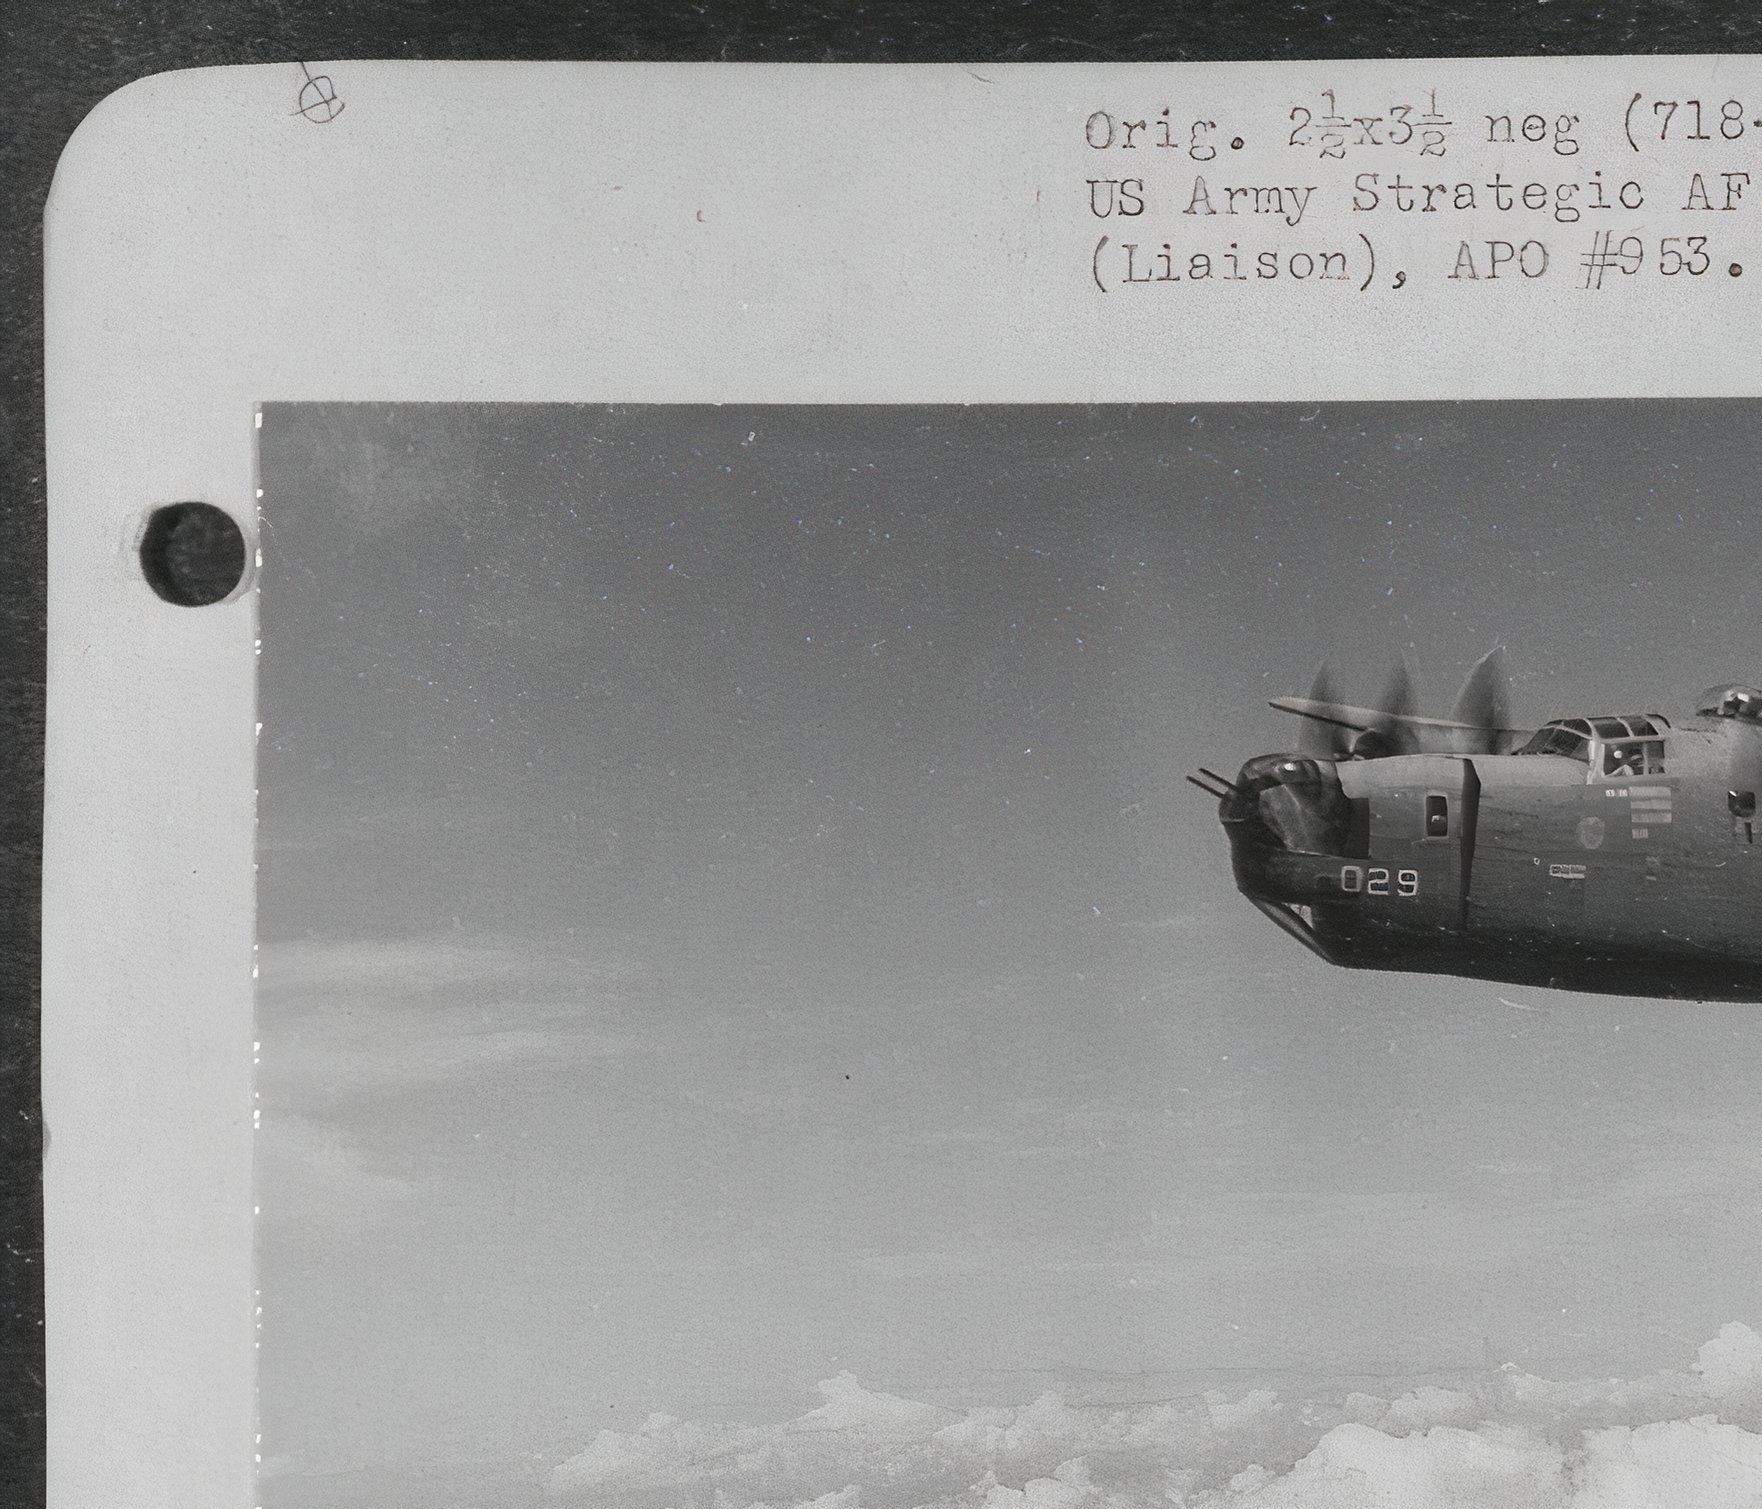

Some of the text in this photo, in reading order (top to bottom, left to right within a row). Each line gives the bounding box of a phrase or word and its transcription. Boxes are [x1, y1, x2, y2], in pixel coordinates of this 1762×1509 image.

[1085, 108, 1244, 161] Orig.
[1485, 114, 1579, 156] neg
[1086, 178, 1145, 219] US
[1183, 176, 1317, 226] Army
[1353, 171, 1645, 223] Strategic
[1093, 230, 1744, 293] (Liaison), APO #953.
[1341, 864, 1419, 896] 029
